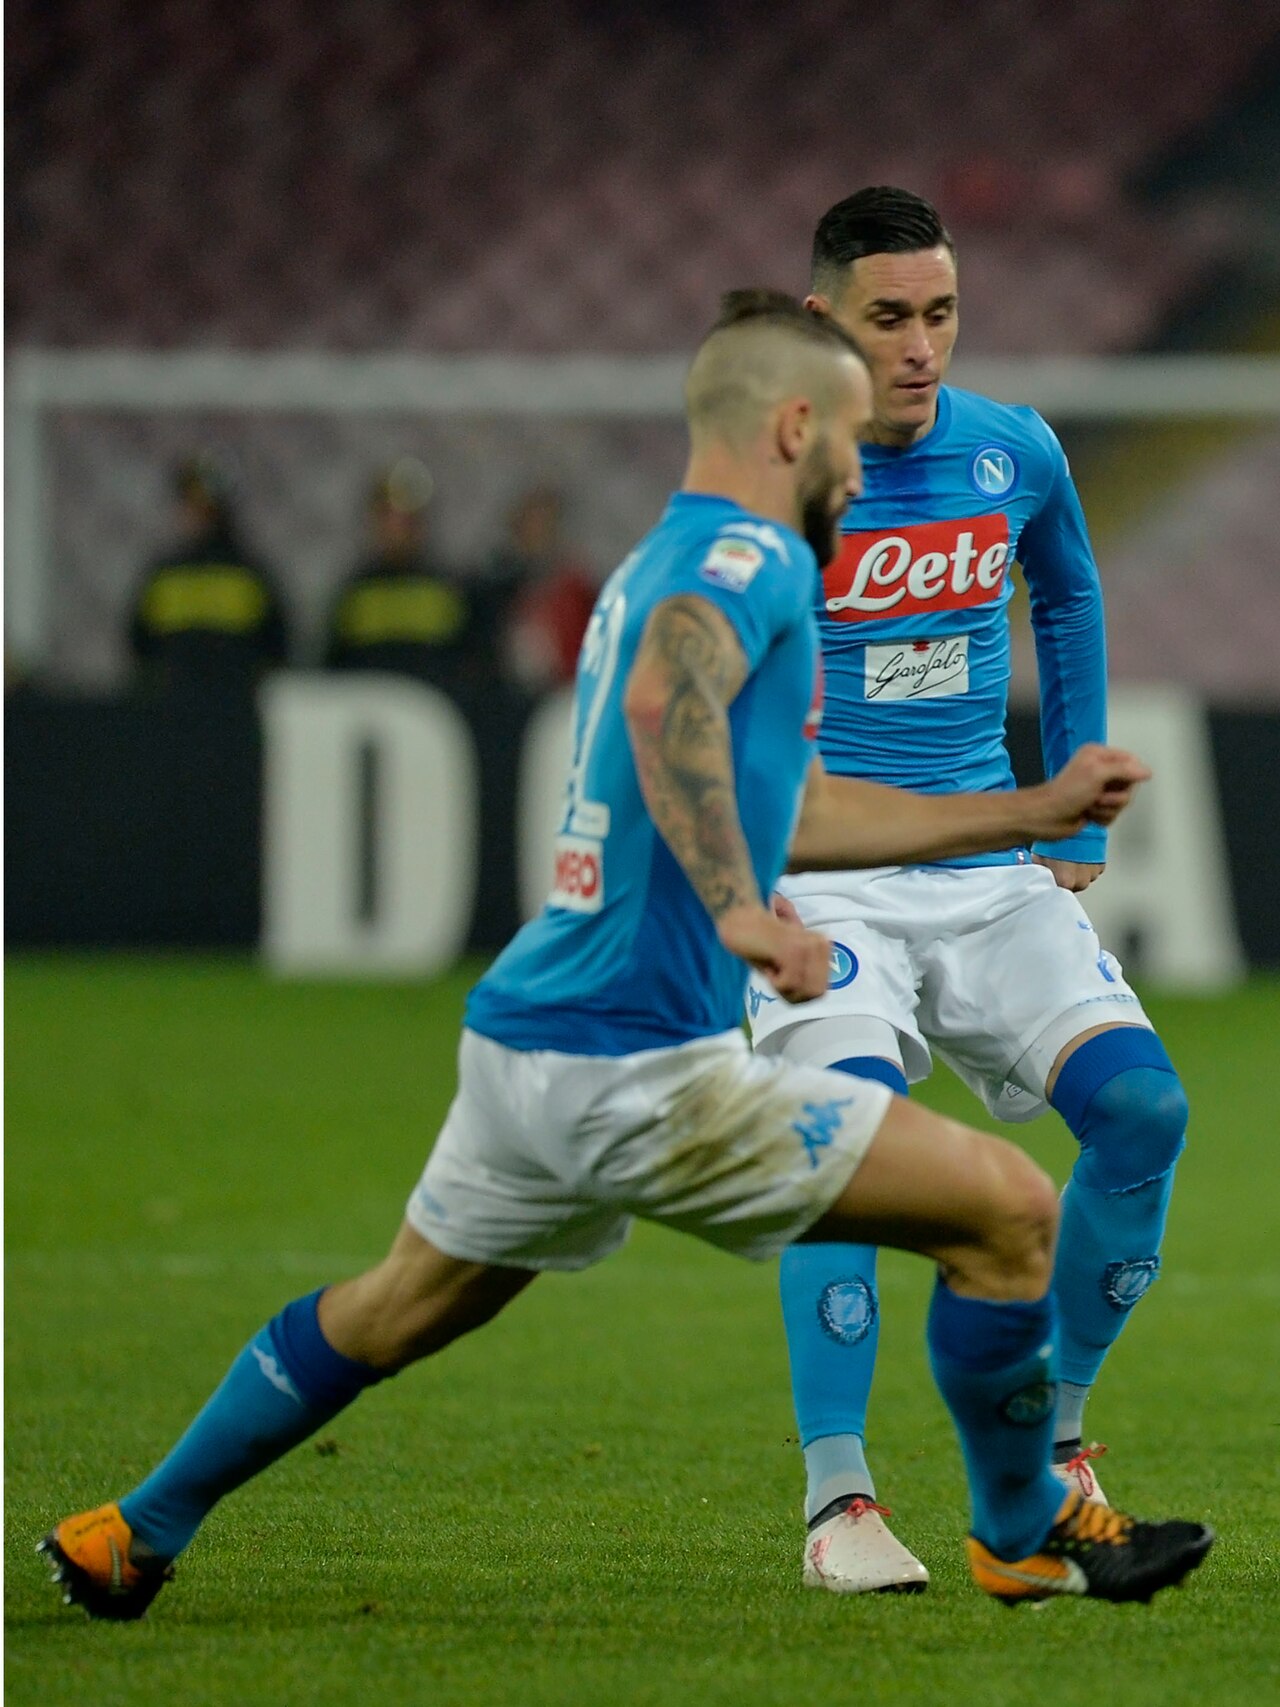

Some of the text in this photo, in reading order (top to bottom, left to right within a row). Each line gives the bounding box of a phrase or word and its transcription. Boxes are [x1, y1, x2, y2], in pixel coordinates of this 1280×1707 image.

[982, 457, 1005, 485] N
[826, 531, 1008, 612] Lete
[866, 640, 967, 699] Garofalo
